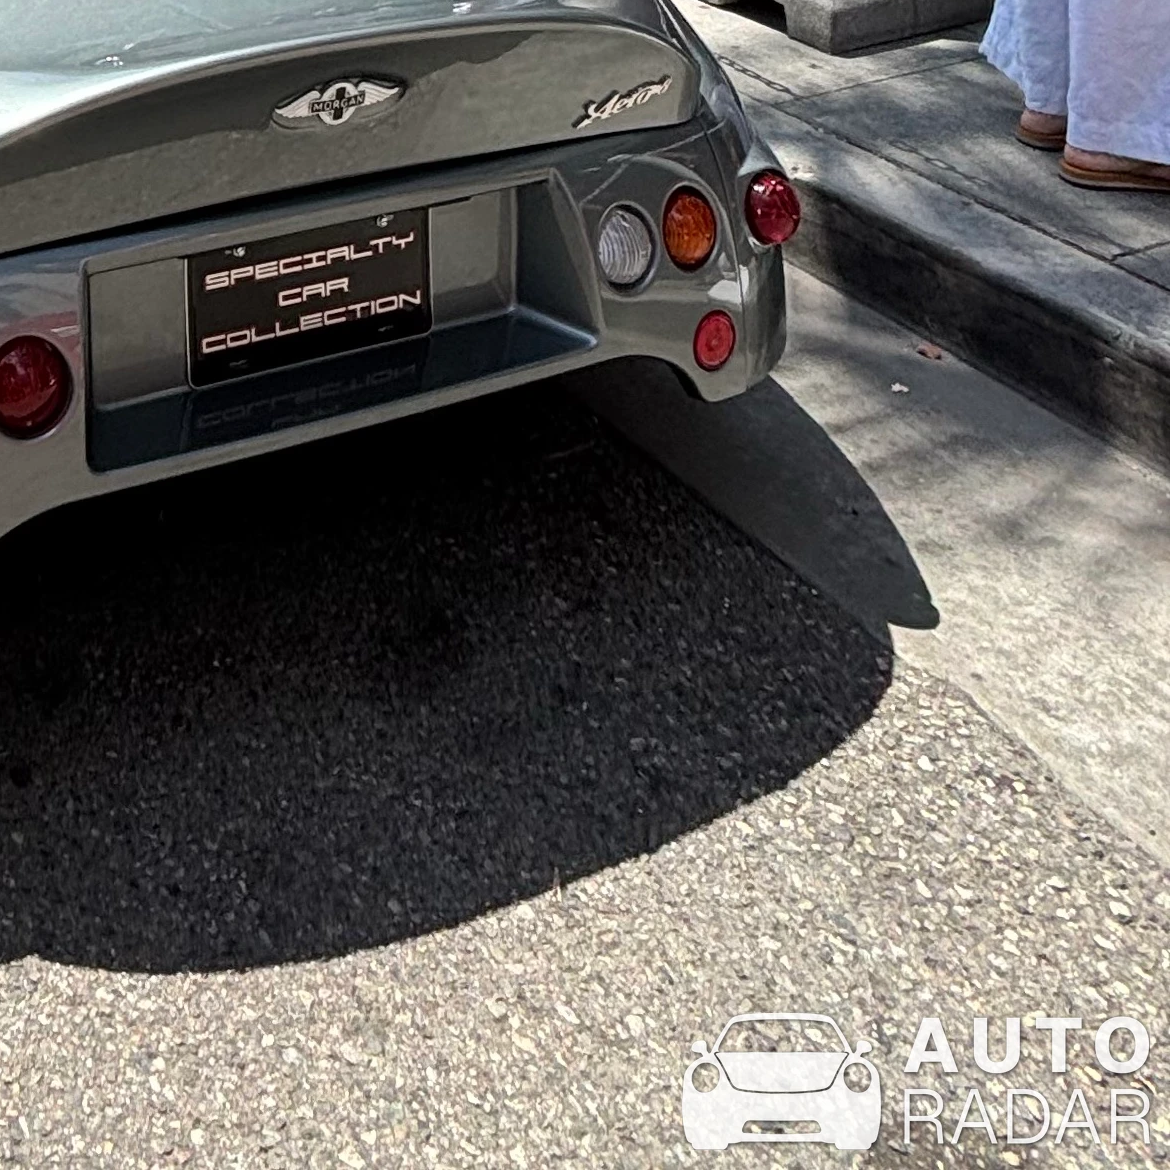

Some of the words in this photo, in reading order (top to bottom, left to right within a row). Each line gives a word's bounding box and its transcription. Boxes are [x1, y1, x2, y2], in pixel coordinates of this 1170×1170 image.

[312, 92, 365, 112] MORGAN
[204, 231, 415, 291] SPECIALTY
[278, 276, 350, 307] CAR
[201, 289, 422, 354] COLLECTION
